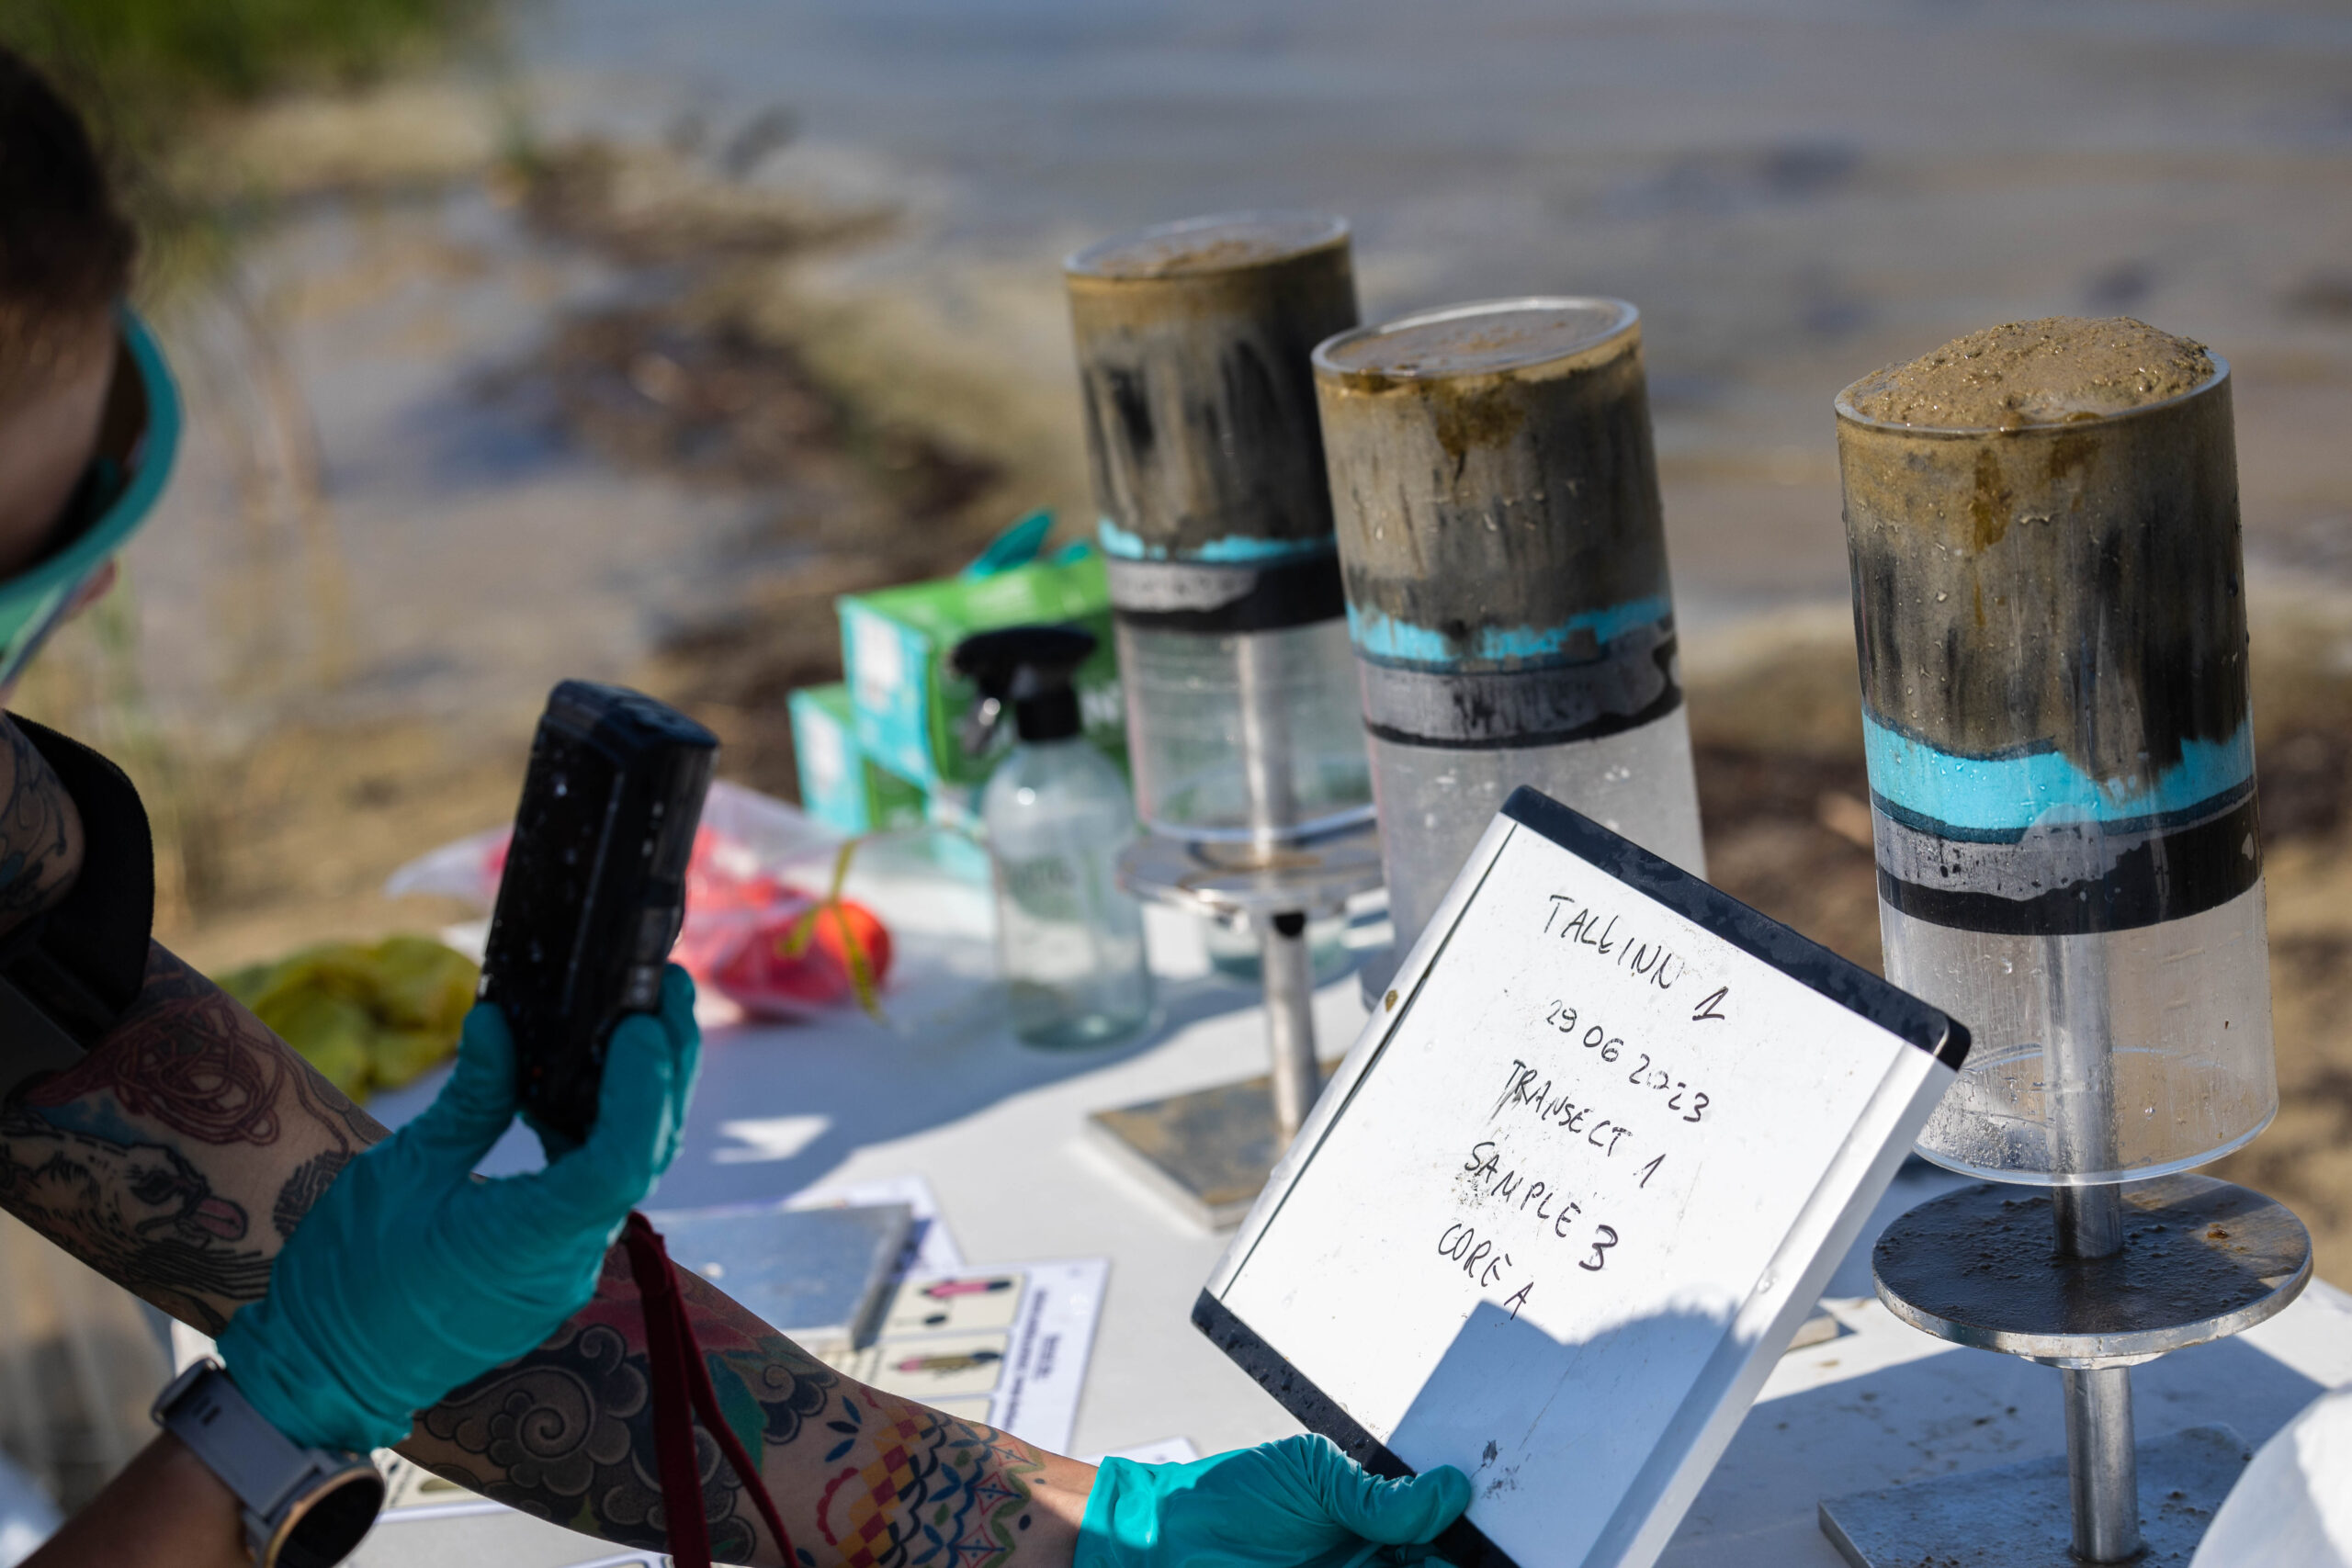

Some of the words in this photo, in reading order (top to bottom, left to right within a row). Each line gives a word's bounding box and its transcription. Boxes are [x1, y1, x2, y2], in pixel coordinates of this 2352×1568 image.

[1544, 895, 1685, 989] TALLINN
[1546, 999, 1577, 1032] 29
[1583, 1025, 1624, 1062] 06
[1503, 1060, 1634, 1156] TRANSECT
[1634, 1154, 1667, 1189] 1
[1464, 1141, 1582, 1238] SAMPLE
[1578, 1224, 1619, 1271] 3
[1438, 1223, 1512, 1287] CORE
[1503, 1281, 1534, 1321] A
